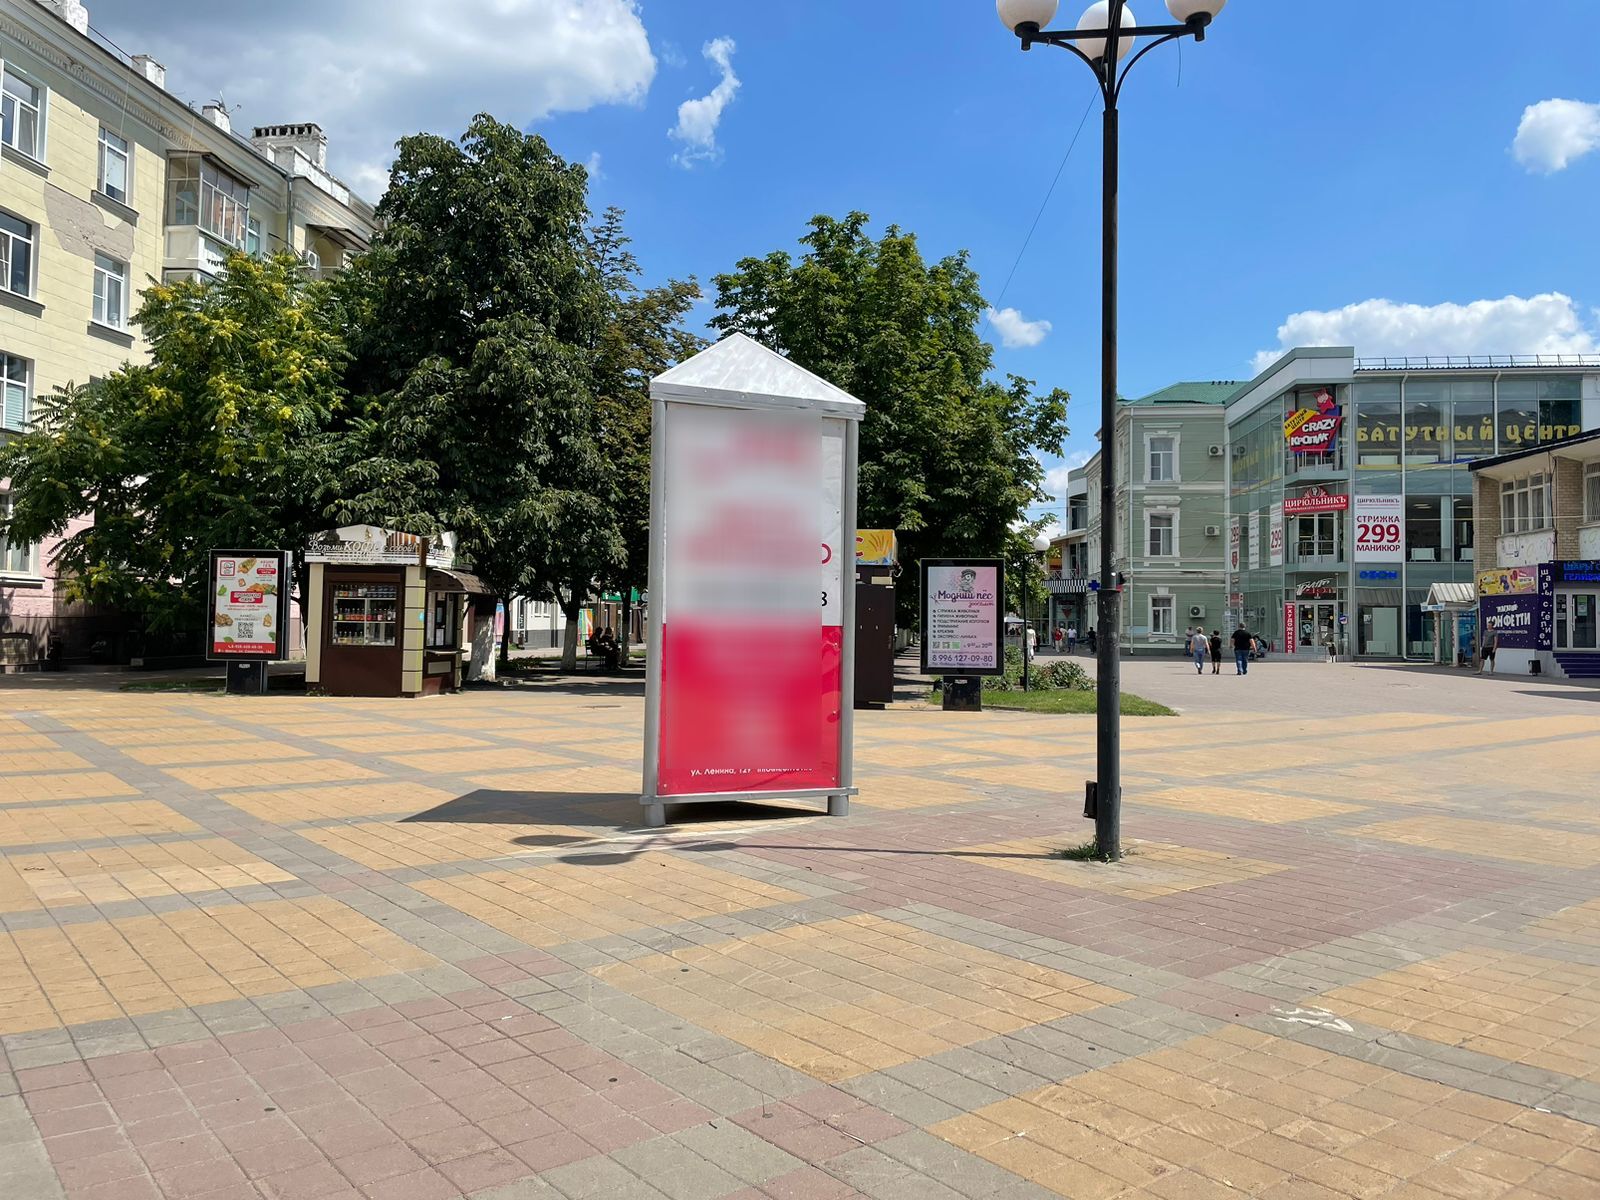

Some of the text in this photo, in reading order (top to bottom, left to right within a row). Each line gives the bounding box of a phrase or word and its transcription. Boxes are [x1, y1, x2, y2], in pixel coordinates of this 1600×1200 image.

[1301, 418, 1337, 433] CRAZY
[1356, 416, 1582, 444] БАТУТНЫЙ ЦЕНТР
[1284, 495, 1347, 508] ЦИРЮЛЬНИКЪ
[1356, 515, 1400, 523] СТРИЖКА
[1356, 544, 1401, 552] МАНИКЮР
[1486, 612, 1531, 629] КОНФЕТТИ
[932, 654, 937, 662] 8
[938, 654, 953, 662] 996
